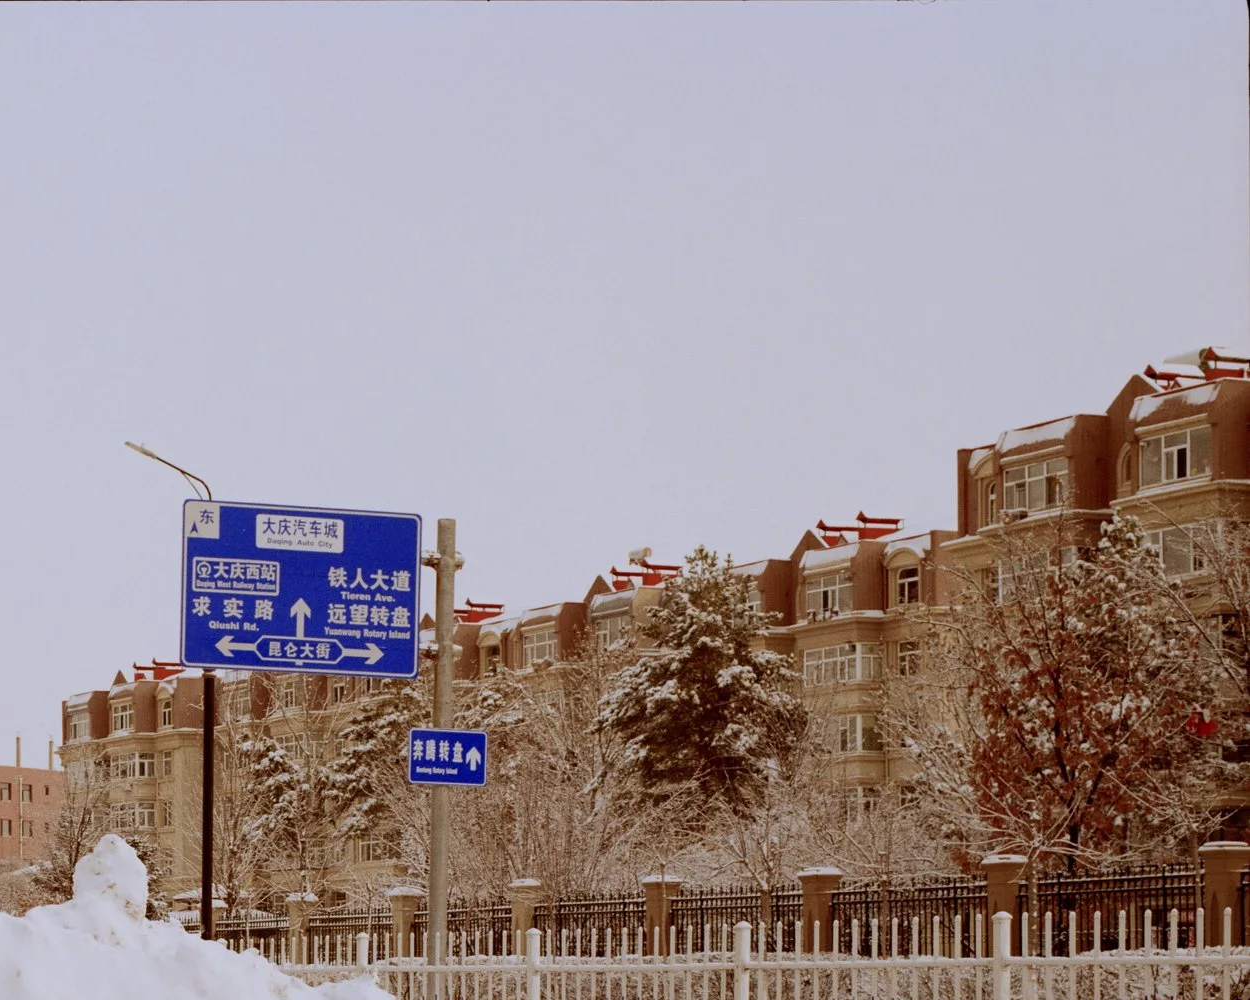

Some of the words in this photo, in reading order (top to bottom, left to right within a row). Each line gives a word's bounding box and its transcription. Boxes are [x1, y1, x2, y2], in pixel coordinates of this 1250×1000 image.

[199, 509, 214, 525] 东
[262, 517, 338, 539] 大庆汽车城
[267, 538, 293, 546] Daqing
[297, 539, 315, 547] Auto
[318, 541, 333, 549] City
[213, 561, 276, 582] 大庆西站
[327, 566, 411, 592] 铁人大道
[340, 591, 371, 602] Tieren
[374, 593, 396, 603] Ave.
[192, 596, 274, 621] 求实路
[327, 603, 411, 628] 远望转盘
[208, 620, 240, 631] Qiushi
[243, 622, 260, 632] Rd.
[324, 626, 361, 639] Yuanwang
[363, 628, 387, 640] Rotary
[389, 630, 411, 640] Island
[268, 641, 331, 660] 昆仑大街
